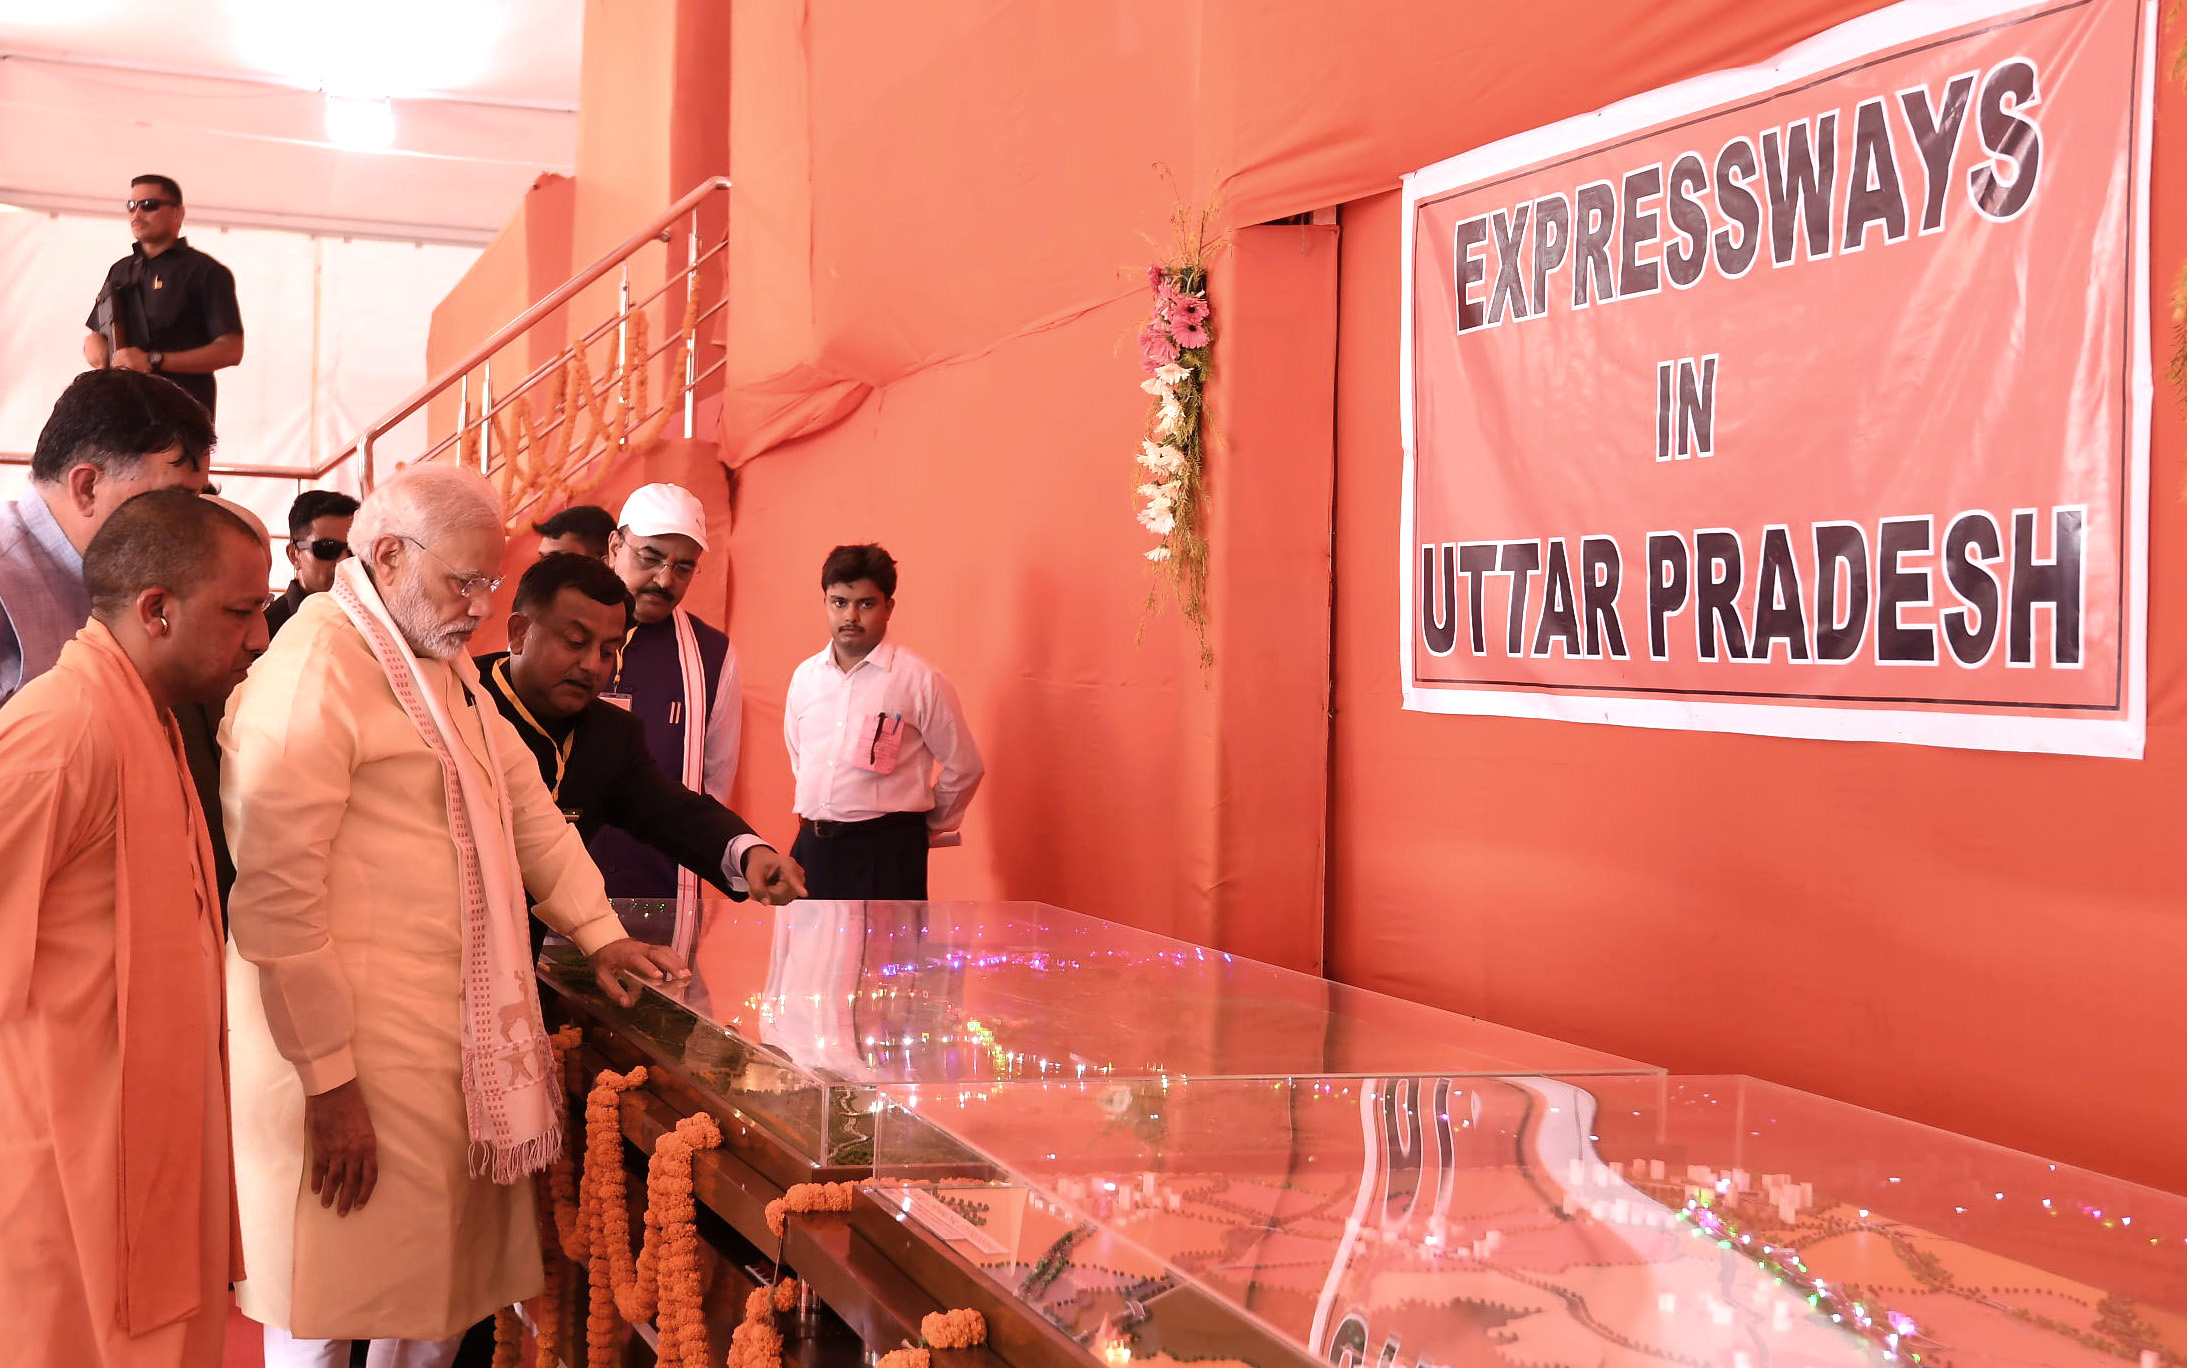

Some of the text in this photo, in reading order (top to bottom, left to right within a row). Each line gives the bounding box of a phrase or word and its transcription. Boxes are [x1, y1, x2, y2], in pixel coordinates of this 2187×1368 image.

[1455, 58, 2042, 334] EXPRESSWAYS
[1656, 354, 1718, 461] IN
[1422, 504, 2087, 669] UTTAR PRADESH
